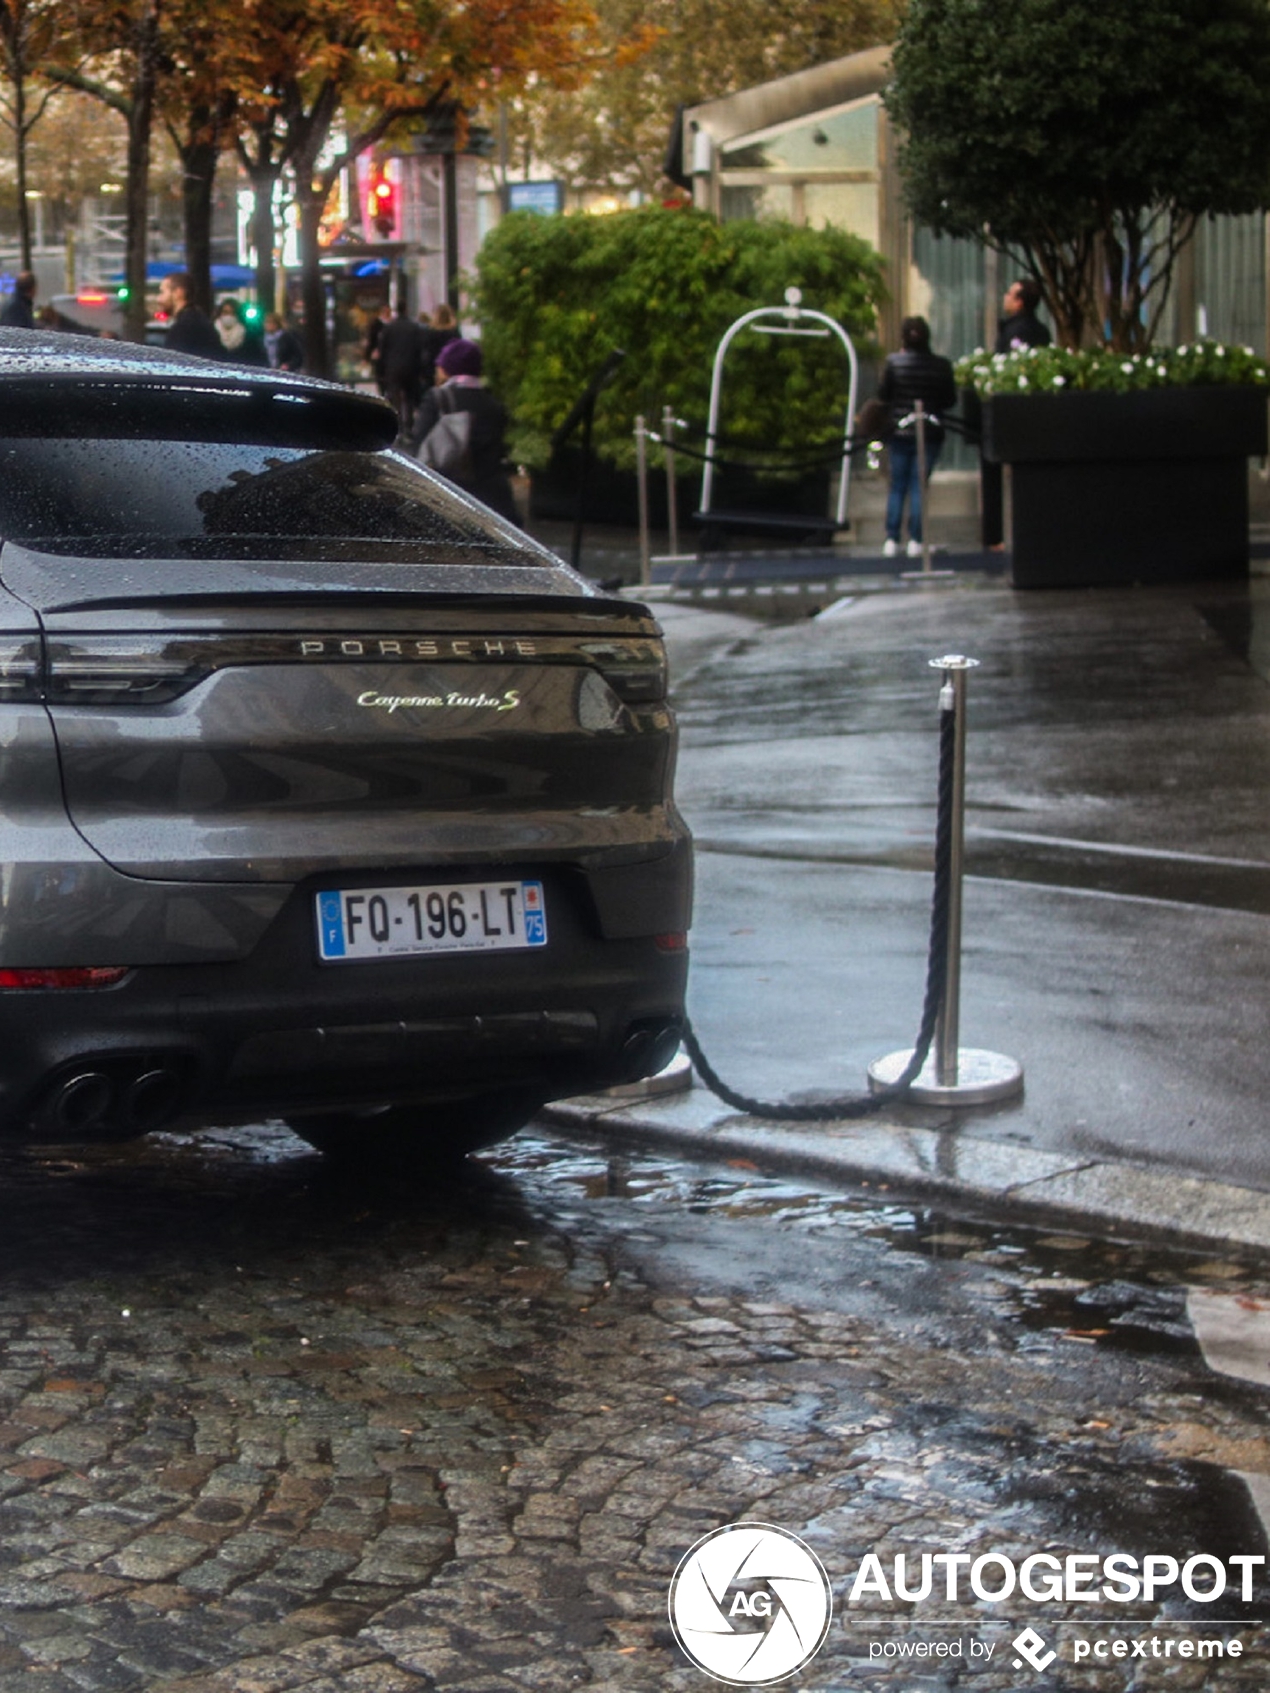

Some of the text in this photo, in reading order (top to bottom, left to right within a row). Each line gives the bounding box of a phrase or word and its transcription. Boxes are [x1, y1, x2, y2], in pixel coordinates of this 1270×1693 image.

[300, 640, 537, 656] PORSCHE
[357, 691, 444, 714] Cayenne
[497, 689, 521, 711] S
[345, 887, 517, 945] FQ-196-LT
[526, 915, 544, 938] 75
[330, 930, 337, 943] F
